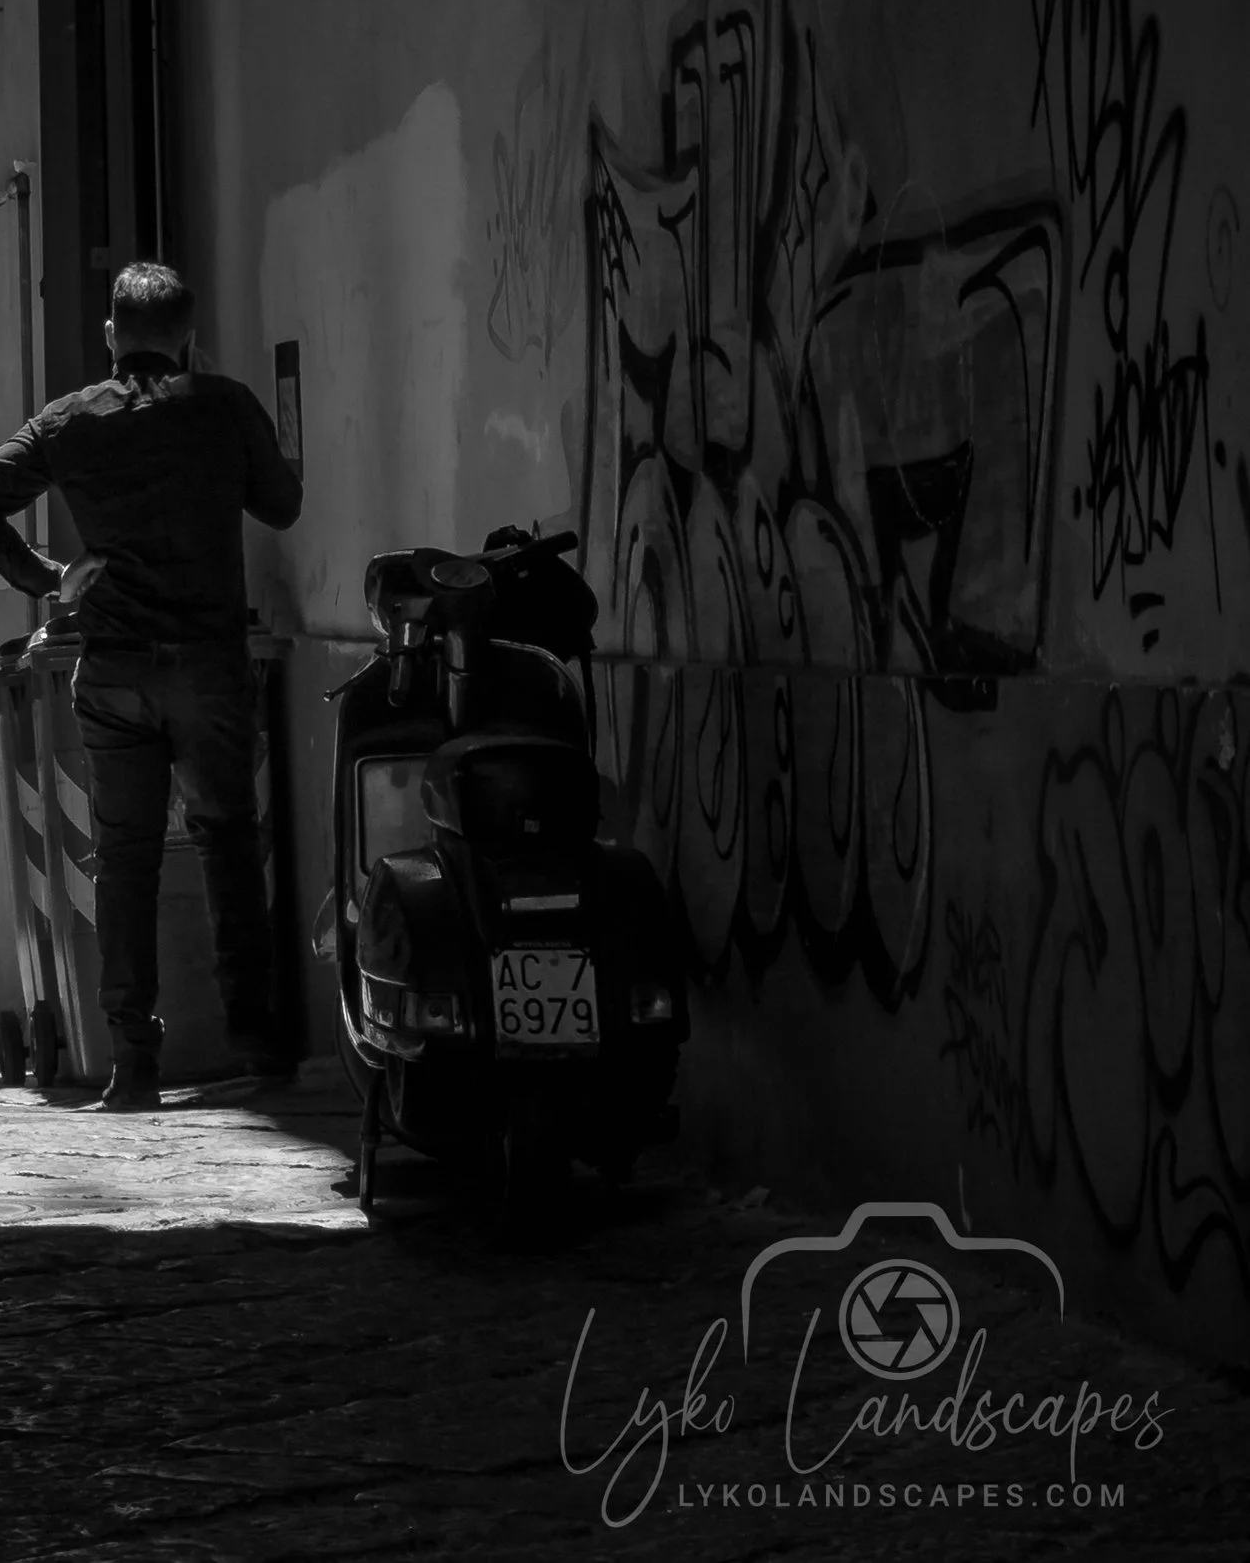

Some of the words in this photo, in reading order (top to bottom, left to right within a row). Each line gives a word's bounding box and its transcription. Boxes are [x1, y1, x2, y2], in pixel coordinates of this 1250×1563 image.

[499, 954, 541, 991] AC
[568, 954, 589, 991] 7
[500, 998, 593, 1034] 6979
